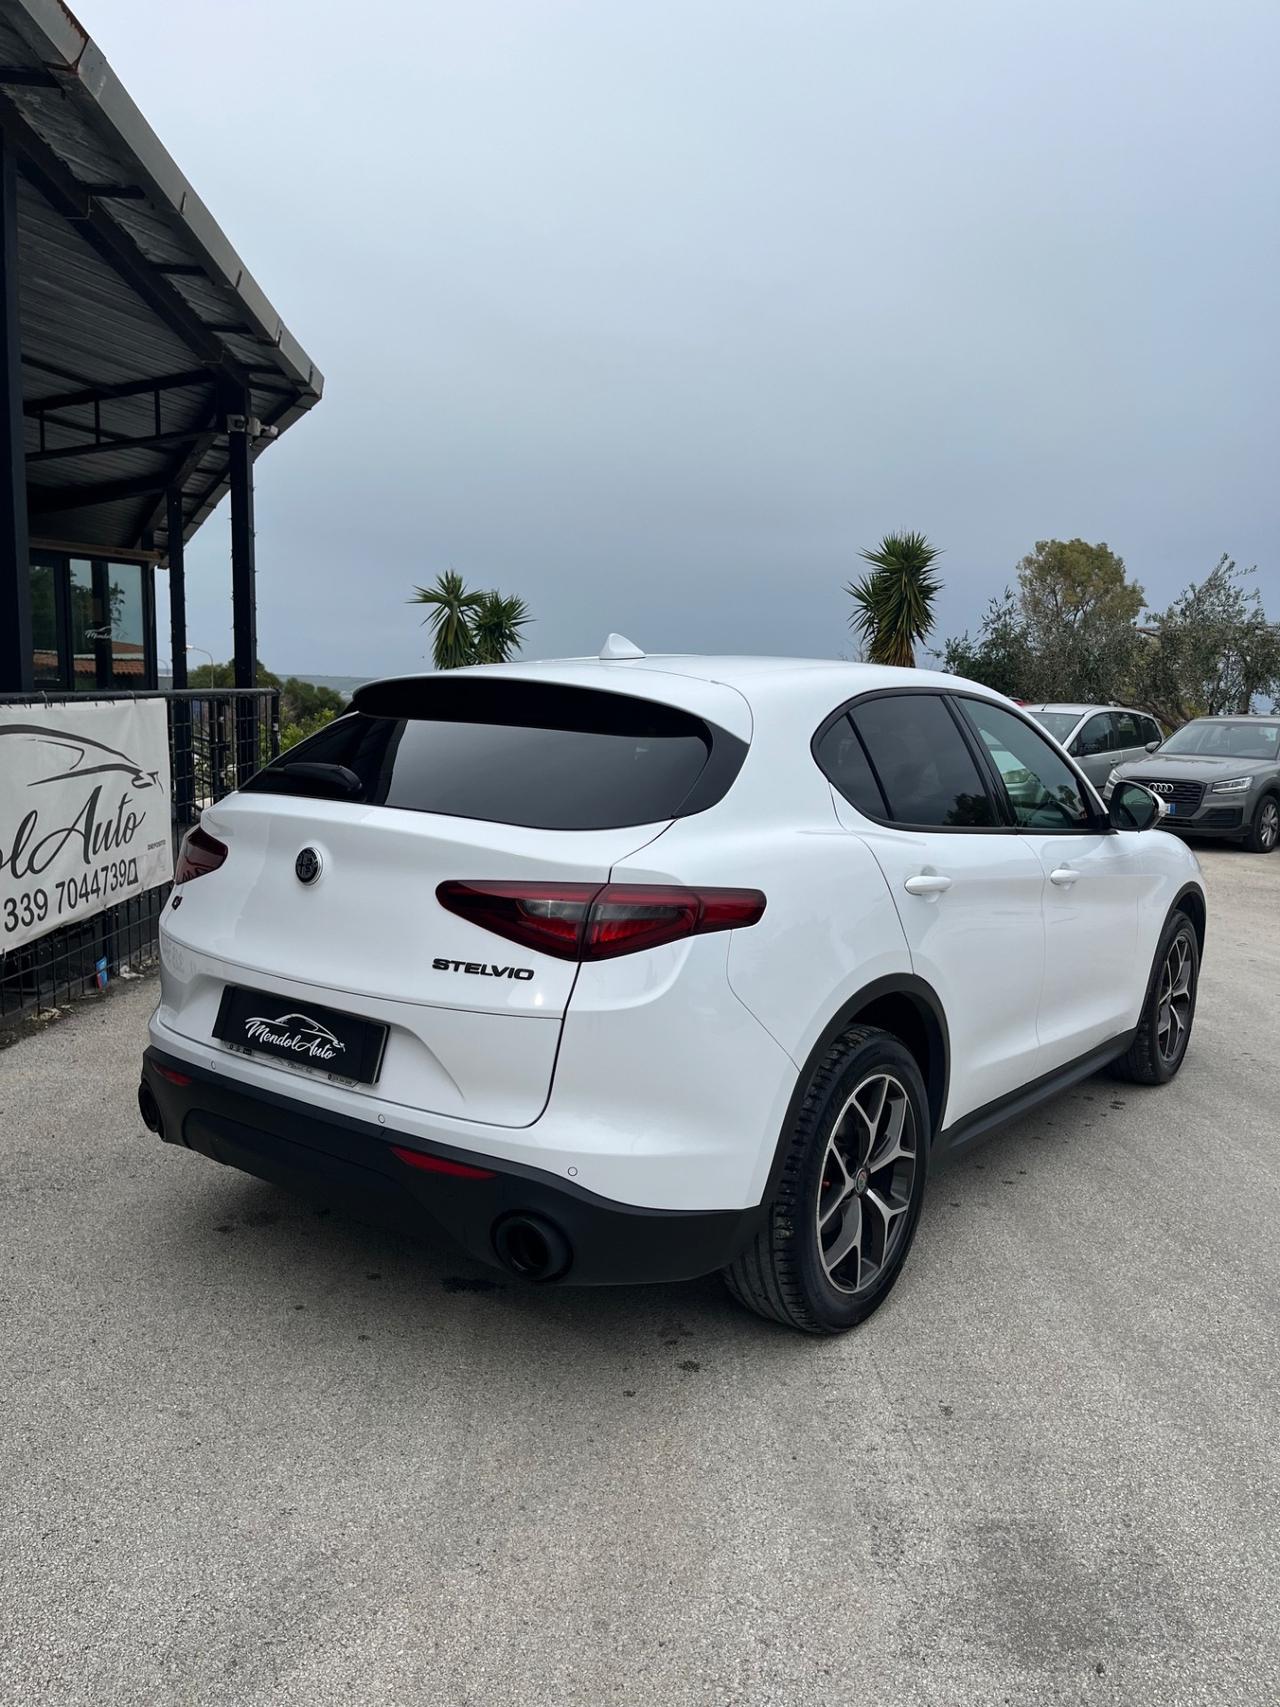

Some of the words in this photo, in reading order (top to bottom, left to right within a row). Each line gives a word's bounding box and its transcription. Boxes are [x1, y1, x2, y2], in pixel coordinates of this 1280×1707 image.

[0, 785, 146, 879] lAuto
[4, 888, 48, 932] 339
[55, 858, 126, 914] 7044739
[432, 958, 535, 980] STELVIO
[245, 1020, 336, 1060] MendolAuto
